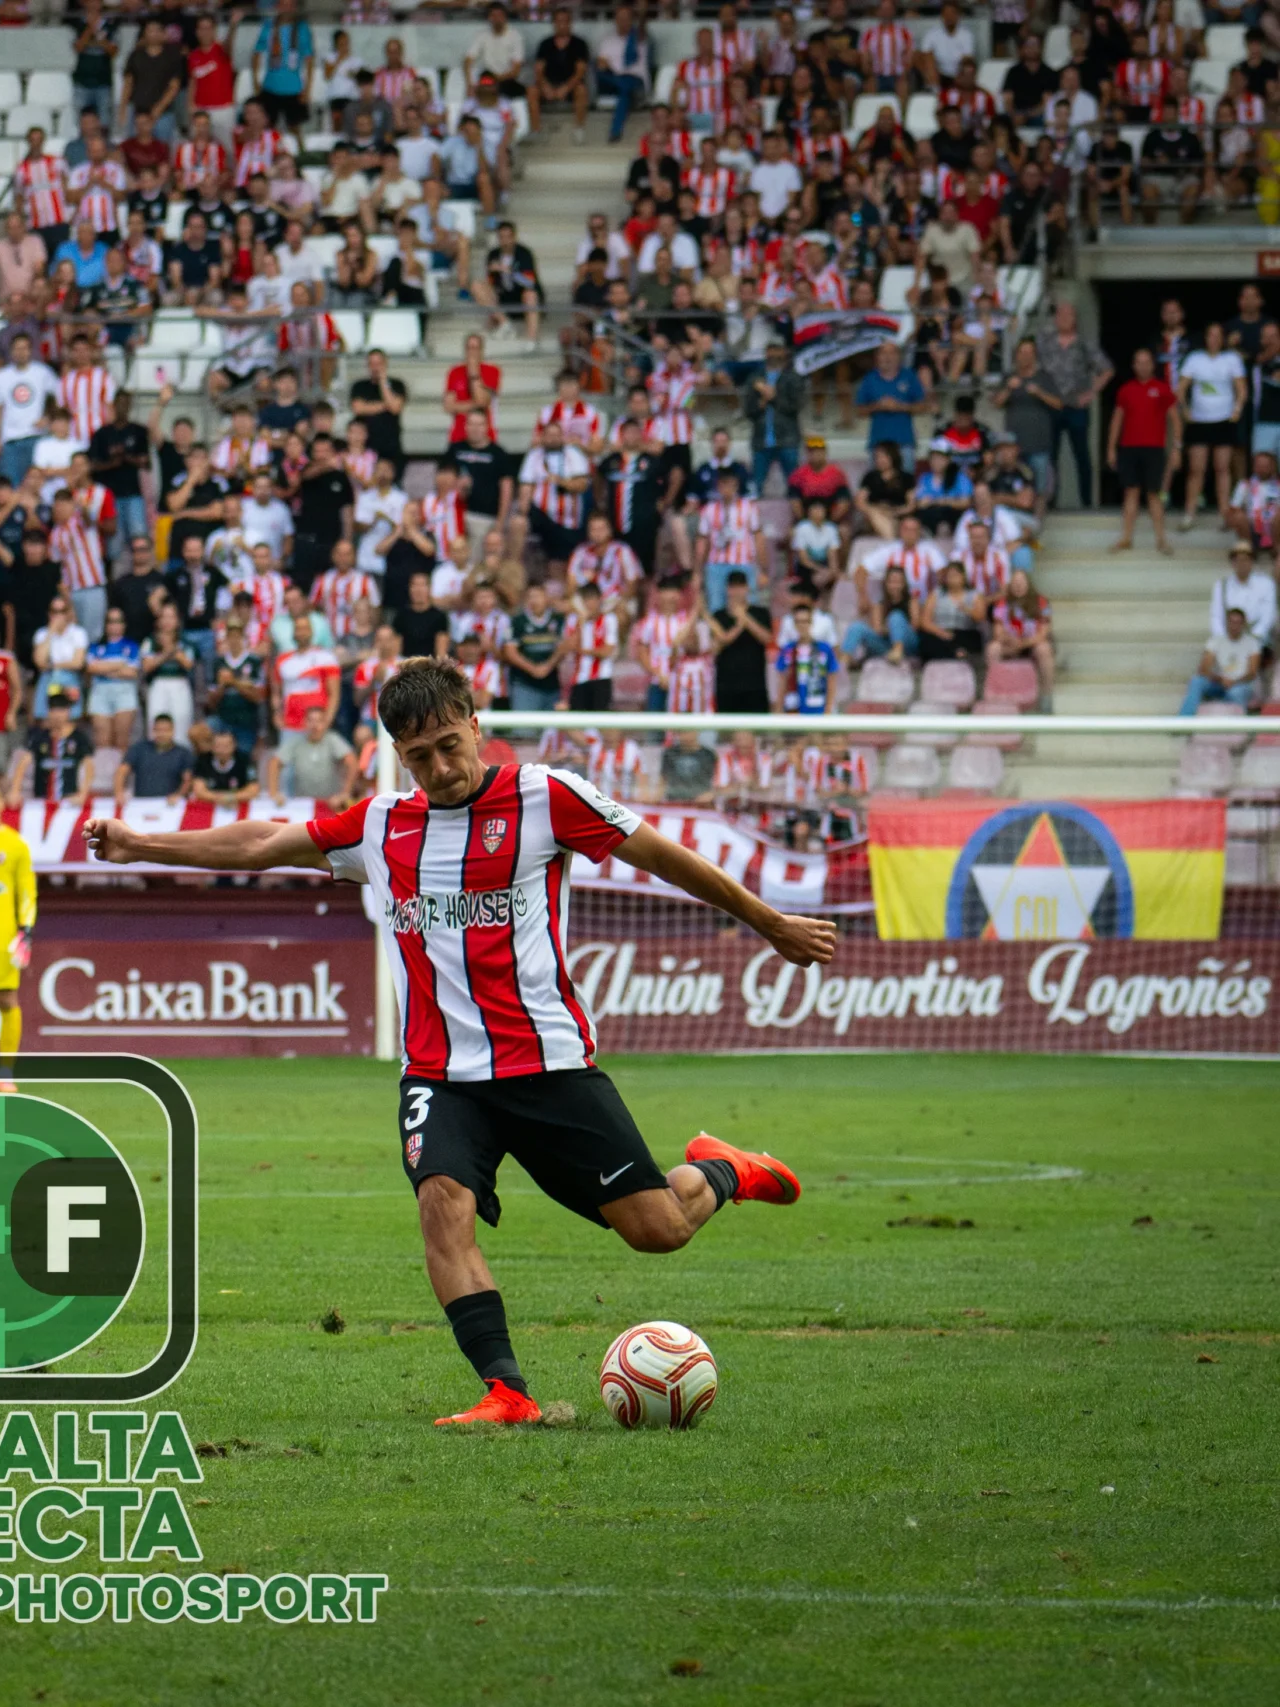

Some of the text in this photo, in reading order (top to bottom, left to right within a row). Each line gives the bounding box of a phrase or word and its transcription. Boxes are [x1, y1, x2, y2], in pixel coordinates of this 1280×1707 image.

[444, 889, 512, 930] HOUSE
[38, 957, 349, 1022] CaixaBank
[565, 941, 1272, 1036] Unión Deportiva Logroñés
[404, 1086, 434, 1131] 3
